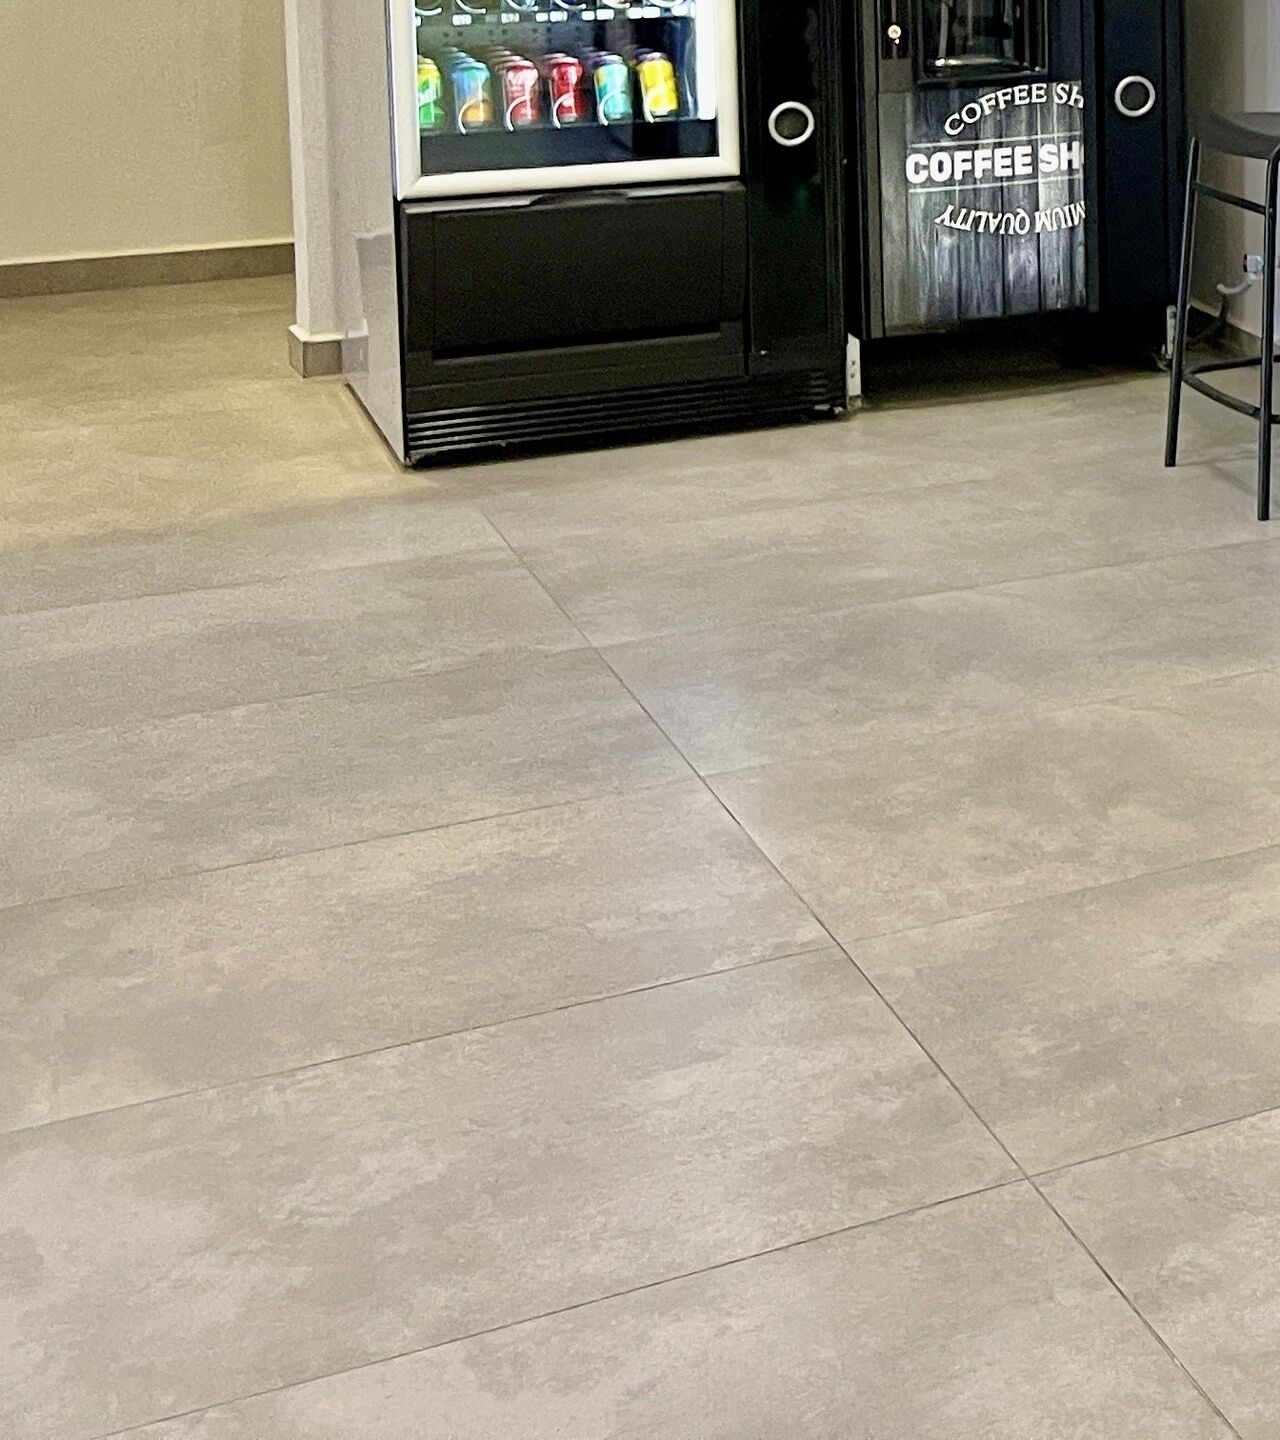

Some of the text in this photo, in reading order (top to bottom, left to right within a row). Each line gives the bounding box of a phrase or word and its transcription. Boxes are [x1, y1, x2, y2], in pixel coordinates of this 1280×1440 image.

[944, 82, 1048, 136] COFFEE
[905, 140, 1085, 185] COFFEE SH
[934, 203, 1031, 236] QUALITY
